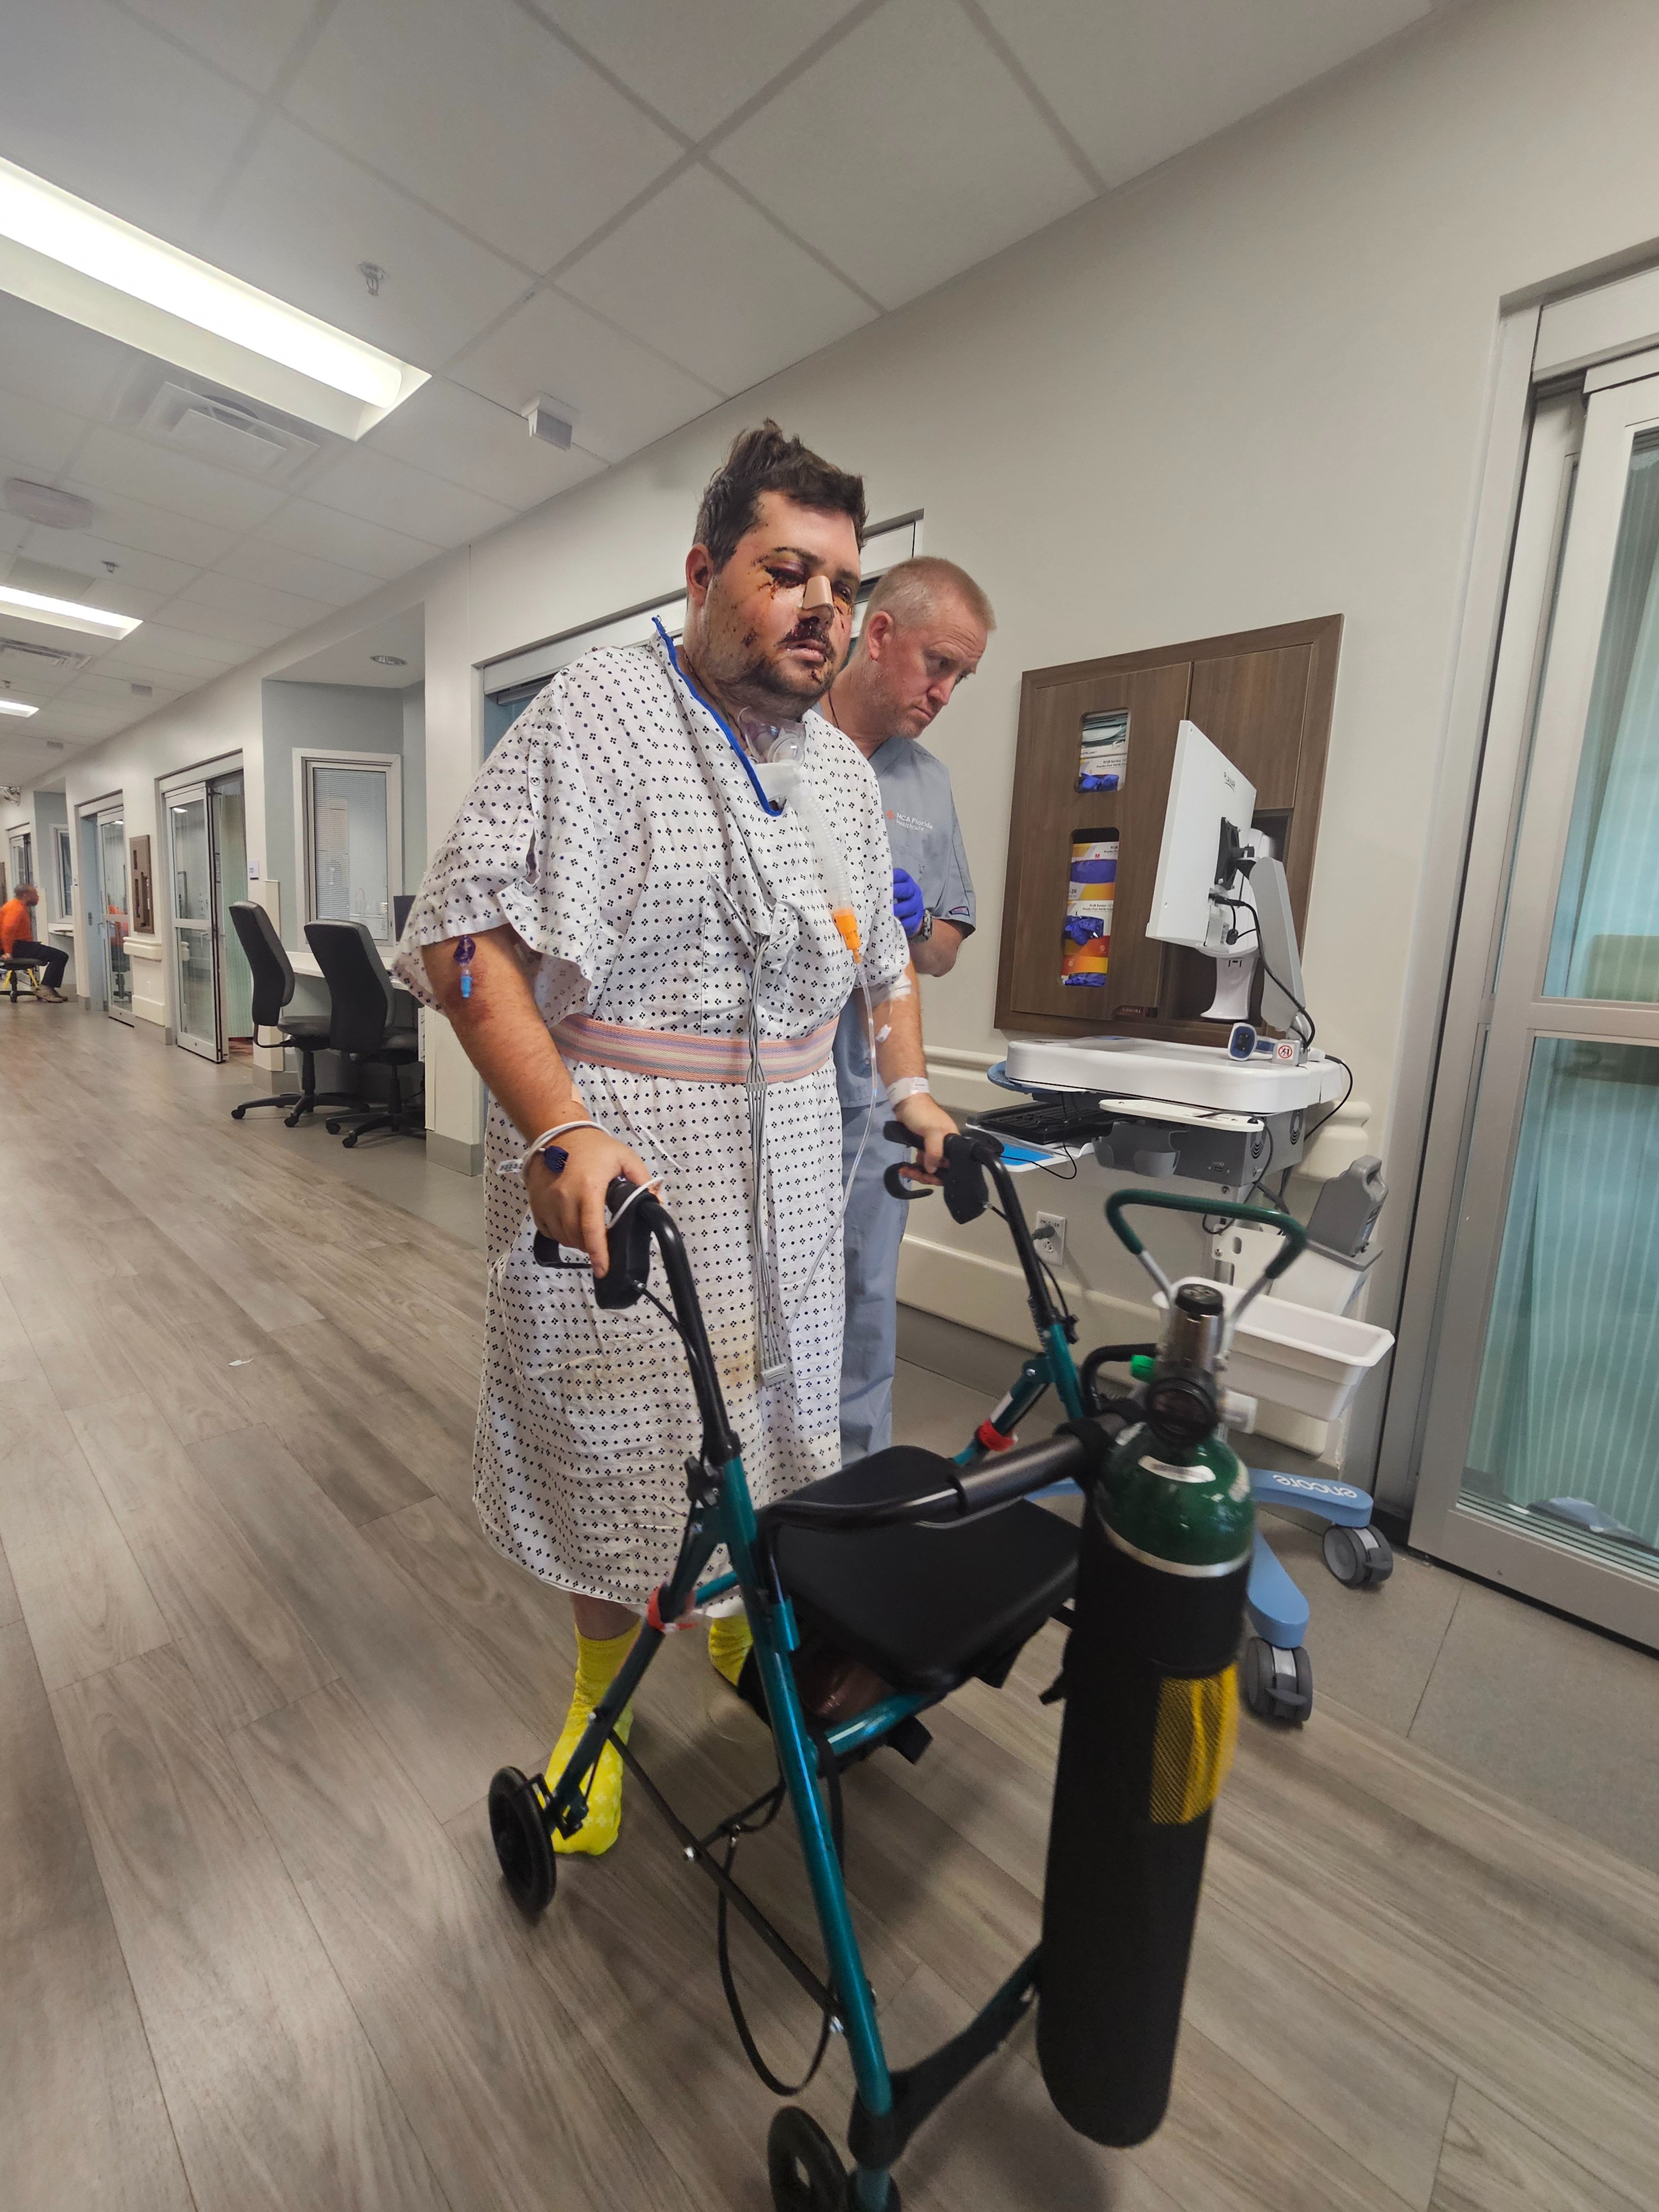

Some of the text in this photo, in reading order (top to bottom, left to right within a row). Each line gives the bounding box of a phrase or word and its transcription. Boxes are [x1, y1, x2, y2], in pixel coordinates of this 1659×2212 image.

[896, 812, 933, 830] HCA Florida
[896, 818, 924, 832] Healthcare
[1272, 1475, 1358, 1498] encore
